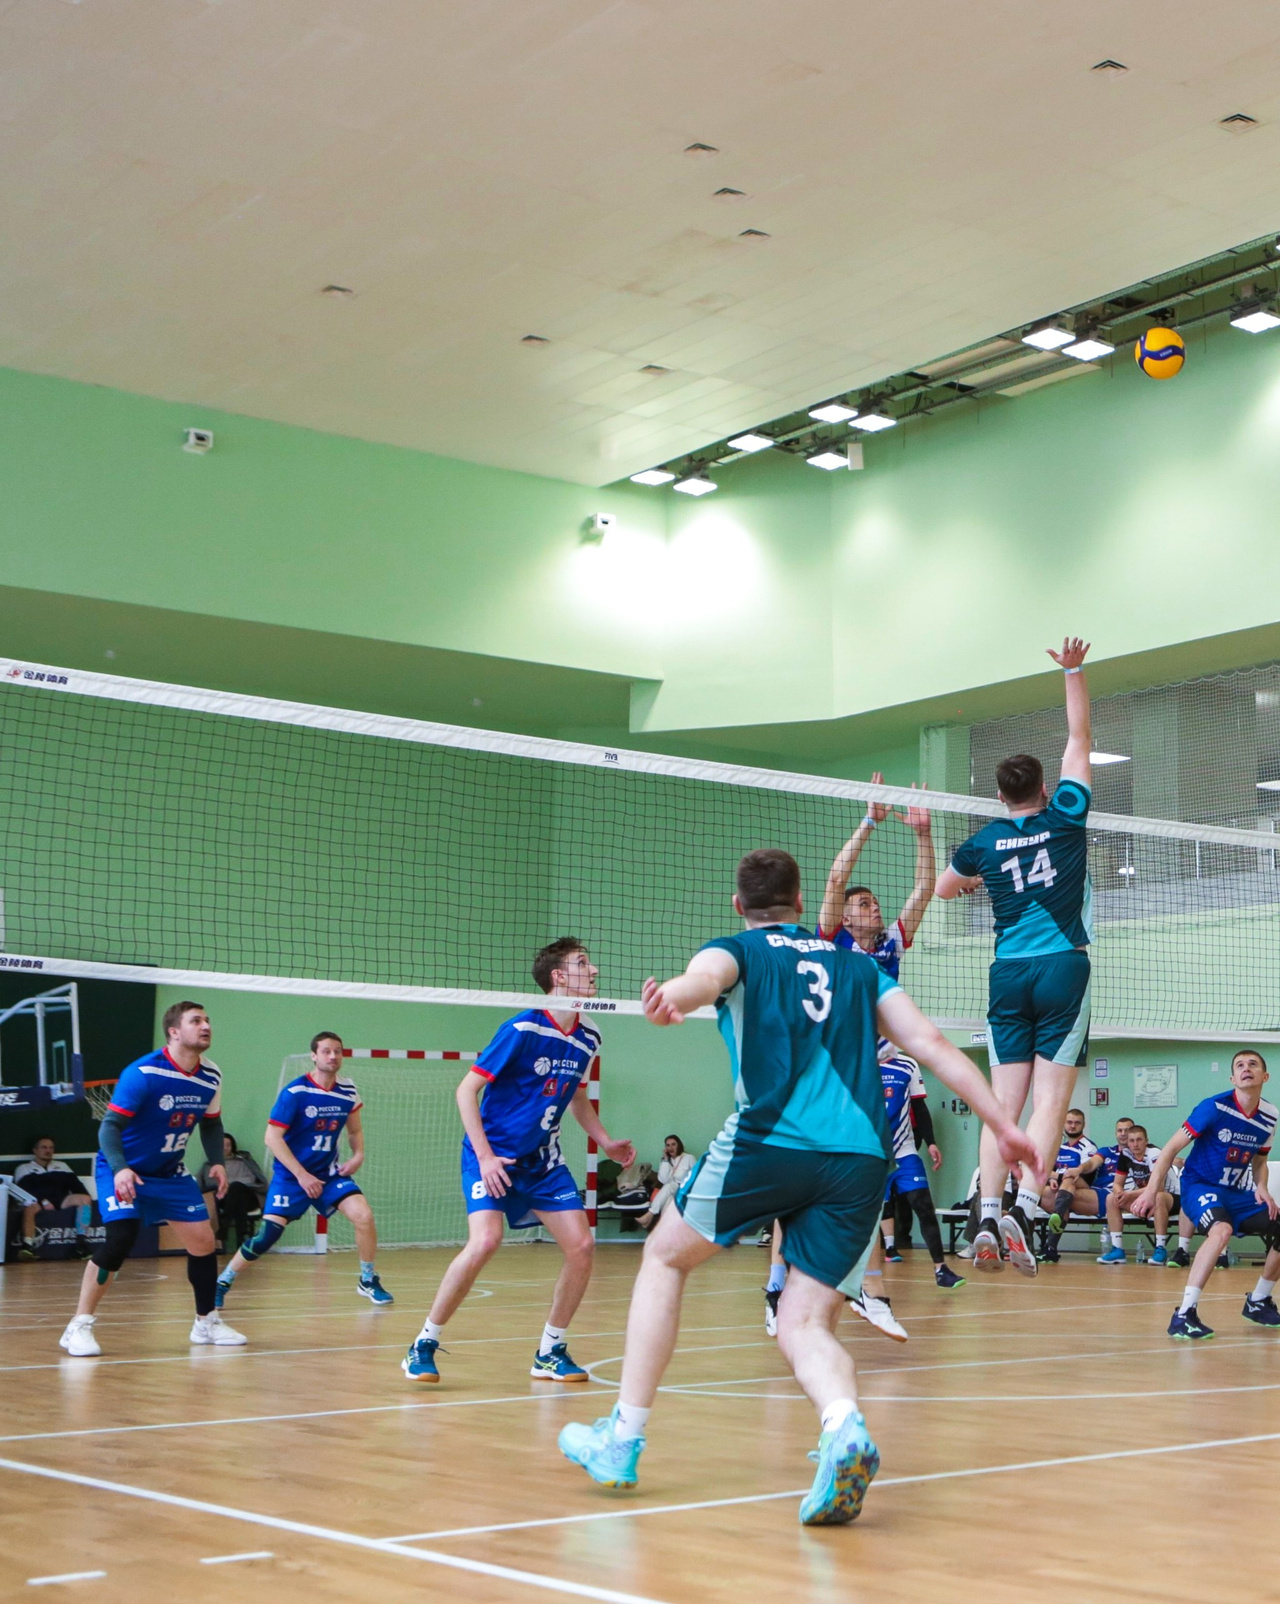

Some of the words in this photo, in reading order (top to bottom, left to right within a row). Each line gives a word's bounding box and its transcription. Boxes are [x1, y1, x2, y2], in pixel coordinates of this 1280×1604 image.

[995, 831, 1051, 851] СИБУР
[1001, 848, 1057, 893] 14
[797, 960, 832, 1023] 3
[160, 1133, 190, 1152] 12
[311, 1135, 332, 1152] 11
[1233, 1132, 1257, 1142] РОССЕТИ
[1219, 1166, 1243, 1187] 17
[471, 1180, 487, 1200] 8
[272, 1194, 290, 1208] 11
